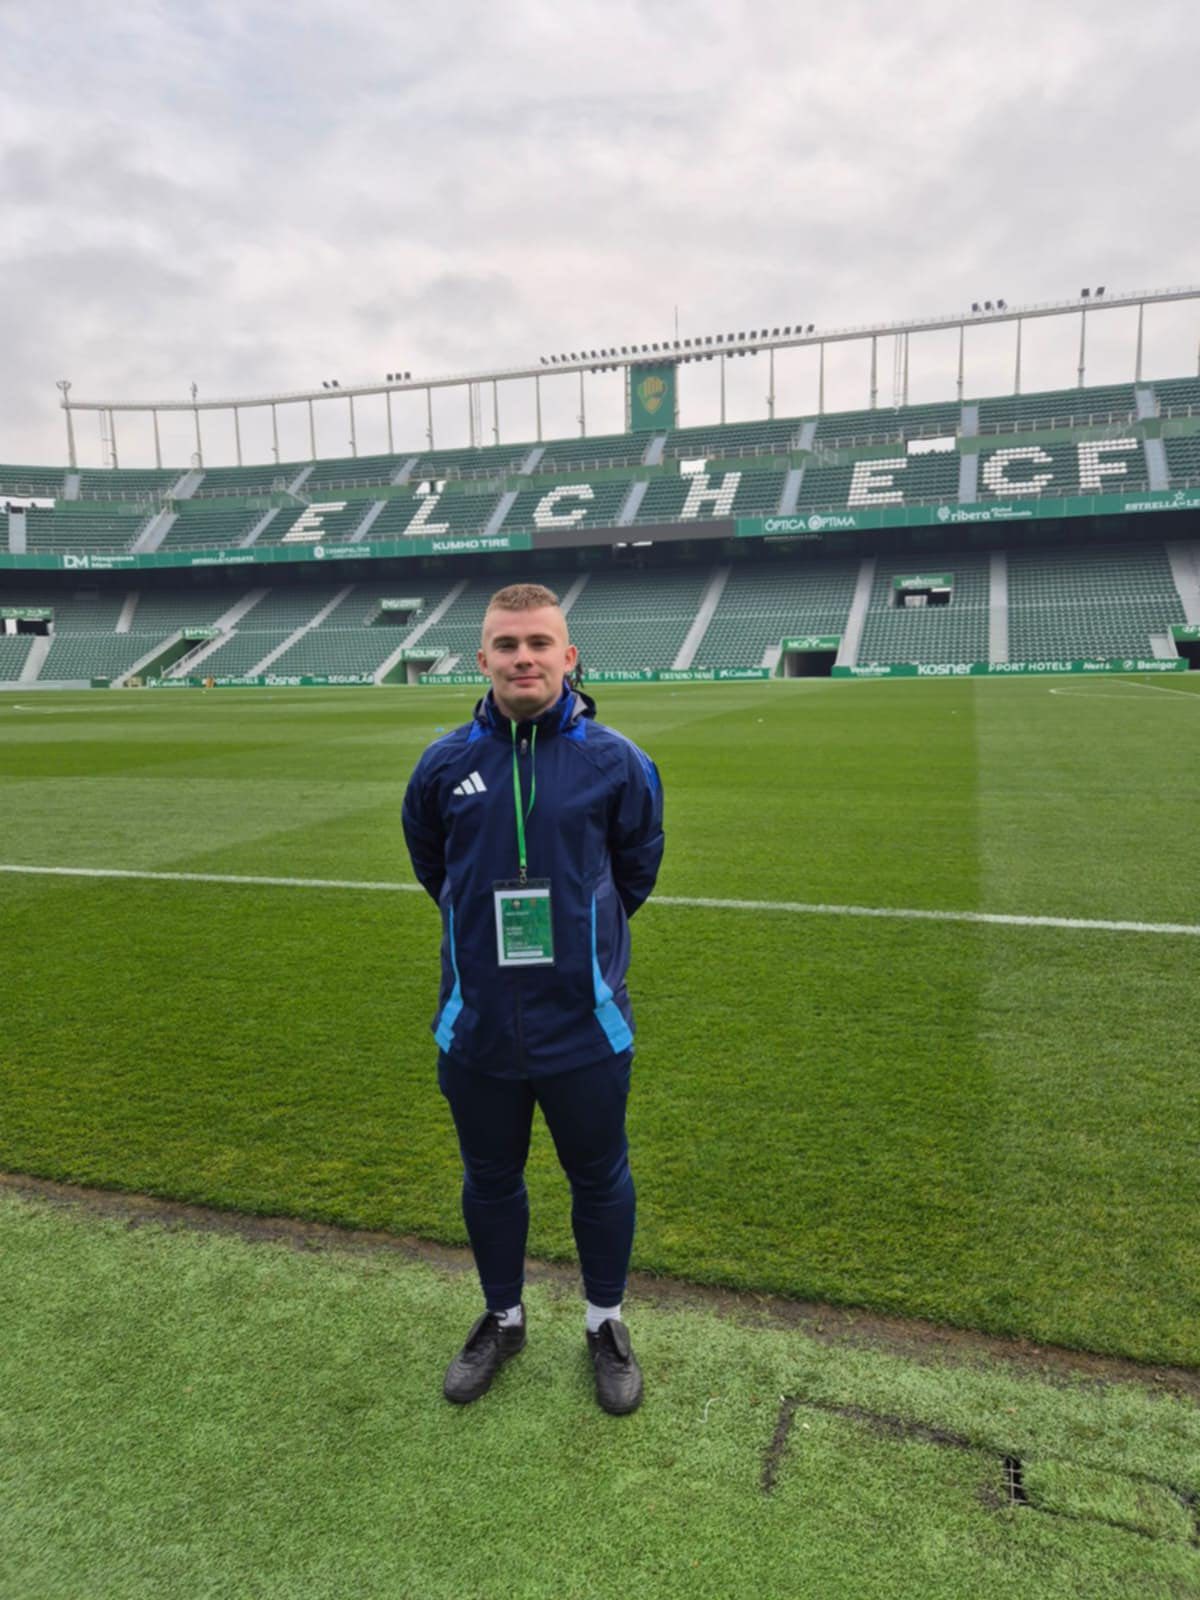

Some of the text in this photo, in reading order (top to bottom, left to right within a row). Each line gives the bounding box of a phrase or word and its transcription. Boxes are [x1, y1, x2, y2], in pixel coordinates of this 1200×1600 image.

[951, 509, 991, 521] ribera
[432, 537, 510, 551] KUMHO TIRE
[64, 555, 89, 568] DM
[1028, 661, 1072, 671] HOTELS
